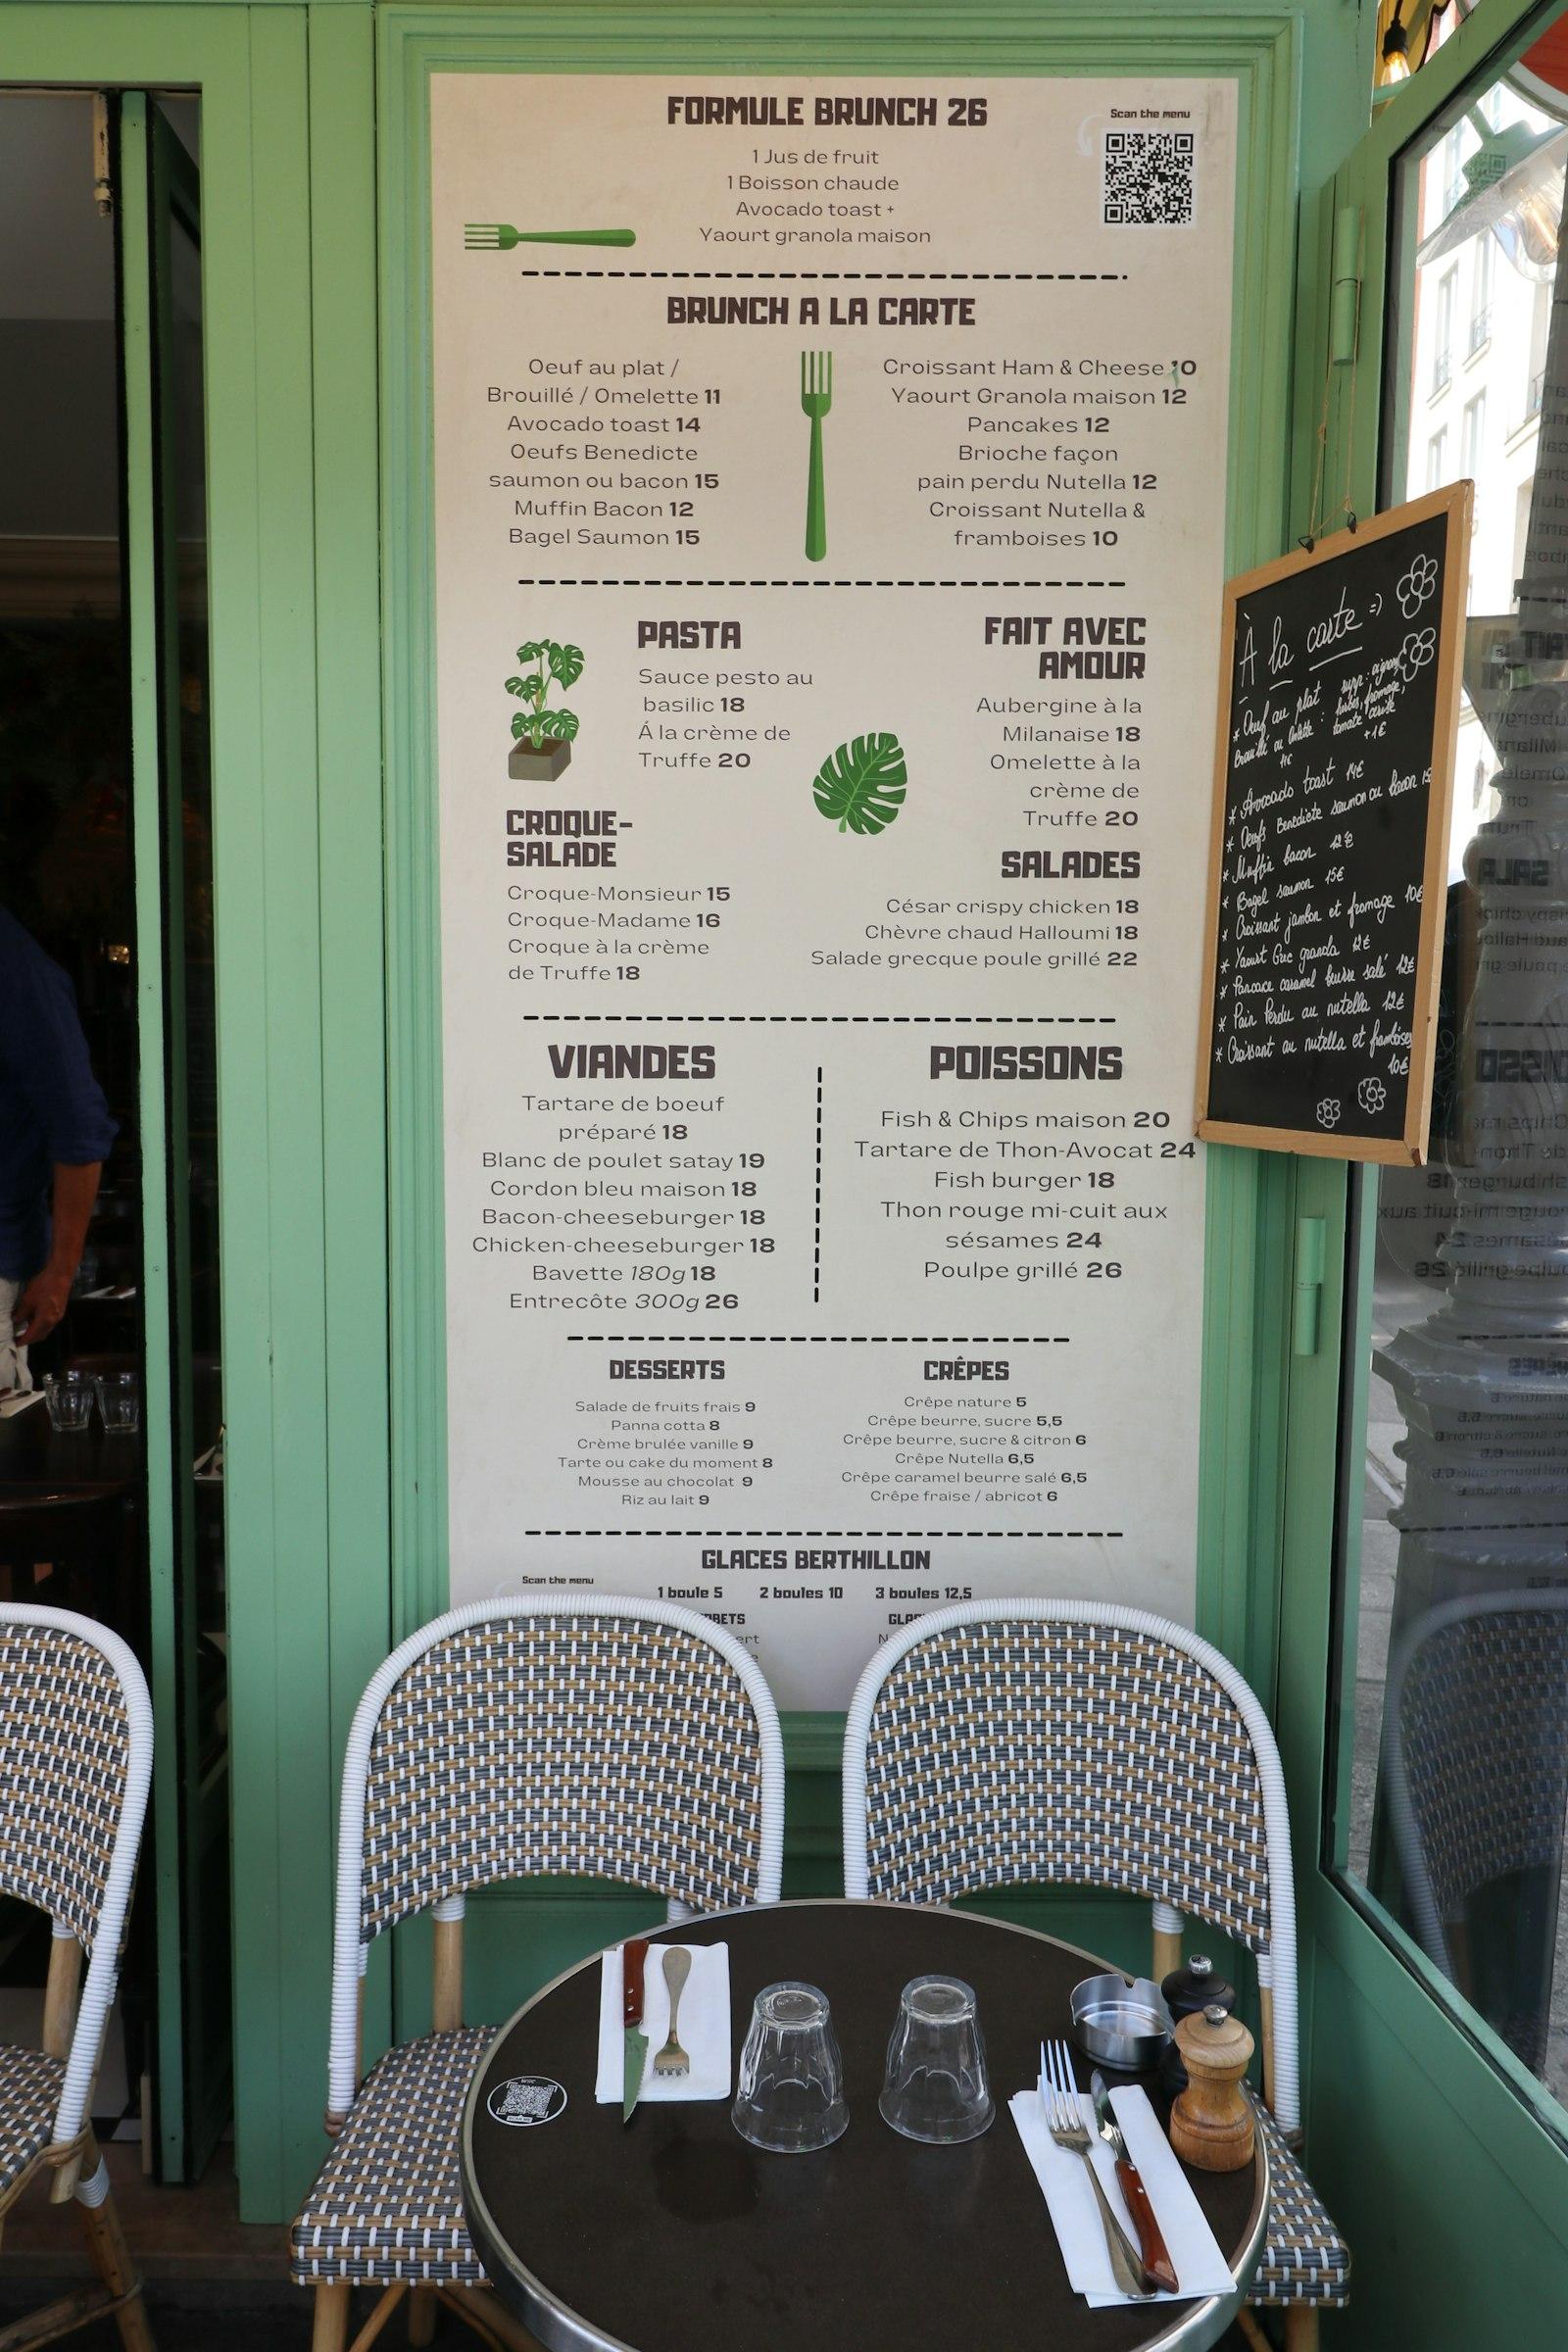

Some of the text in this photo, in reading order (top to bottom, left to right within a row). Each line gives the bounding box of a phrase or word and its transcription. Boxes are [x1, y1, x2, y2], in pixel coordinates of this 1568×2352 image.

[667, 96, 988, 126] FORMULE BRUNCH 26
[1109, 108, 1191, 120] Scan the menu
[698, 226, 931, 246] Yaourt granola maison
[667, 296, 975, 325] BRUNCH A LA CARTE
[487, 386, 720, 405] Brouillé / Omelette 11
[507, 415, 702, 433] Avocado toast 14
[967, 416, 1110, 433] Pancakes 12
[510, 443, 698, 462] Oeufs Benedicte
[958, 444, 1118, 466] Brioche façon
[514, 500, 694, 517] Muffin Bacon 12
[953, 529, 1118, 547] framboises 10
[638, 620, 741, 649] PASTA
[985, 616, 1147, 645] FAIT AVEC
[1268, 615, 1295, 674] la
[1307, 586, 1362, 653] carte
[1039, 652, 1146, 679] AMOUR
[638, 667, 813, 688] Sauce pesto au
[643, 696, 746, 713] basilic 18
[1273, 708, 1290, 724] au
[1295, 680, 1322, 724] plat
[1003, 725, 1141, 743] Milanaise 18
[1333, 712, 1362, 735] tomate
[638, 752, 752, 768] Truffe 20
[1240, 758, 1364, 819] Avocado toast 14€
[1389, 769, 1418, 797] bacon
[507, 809, 632, 839] CROQUE-
[507, 841, 616, 867] SALADE
[1002, 851, 1140, 878] SALADES
[1232, 844, 1316, 884] Muffin bacon
[507, 885, 731, 904] Croque-Monsieur 15
[1237, 866, 1345, 918] Bagel saumon 15€
[886, 898, 1140, 917] César crispy chicken 18
[1284, 903, 1322, 945] jambon
[1329, 900, 1342, 918] et
[1348, 891, 1395, 929] fromage
[508, 911, 721, 930] Croque-Madame 16
[1280, 953, 1415, 992] caramel salé 12€
[1234, 991, 1404, 1030] Pain Perdu au nutella 12€
[1282, 1040, 1298, 1054] au
[1304, 1028, 1347, 1052] nutella
[1352, 1024, 1366, 1048] et
[548, 1045, 715, 1079] VIANDES
[930, 1046, 1122, 1080] POISSONS
[1388, 1053, 1409, 1075] 10€
[935, 1170, 1115, 1193] Fish burger 18
[482, 1208, 766, 1229] Bacon-cheeseburger 18
[472, 1236, 776, 1257] Chicken-cheeseburger 18
[924, 1261, 1122, 1283] Poulpe grillé 26
[510, 1293, 739, 1313] Entrecôte 300g 26
[609, 1358, 726, 1381] DESSERTS
[924, 1355, 1009, 1381] CRÊPES
[575, 1400, 756, 1413] Salade de fruits frais 9
[904, 1396, 1026, 1409] Crêpe nature 5
[611, 1419, 719, 1432] Panna cotta 8
[895, 1452, 1035, 1466] Crêpe Nutella 6,5
[701, 1548, 931, 1571] GLACES BERTHILLON
[521, 1575, 547, 1585] Scan
[548, 1575, 567, 1585] the
[666, 1586, 710, 1599] boule
[713, 1587, 722, 1598] 5
[760, 1587, 768, 1598] 2
[772, 1586, 824, 1599] boules
[828, 1586, 844, 1599] 10
[876, 1587, 884, 1598] 3
[889, 1586, 940, 1600] boules
[944, 1586, 973, 1601] 12,5
